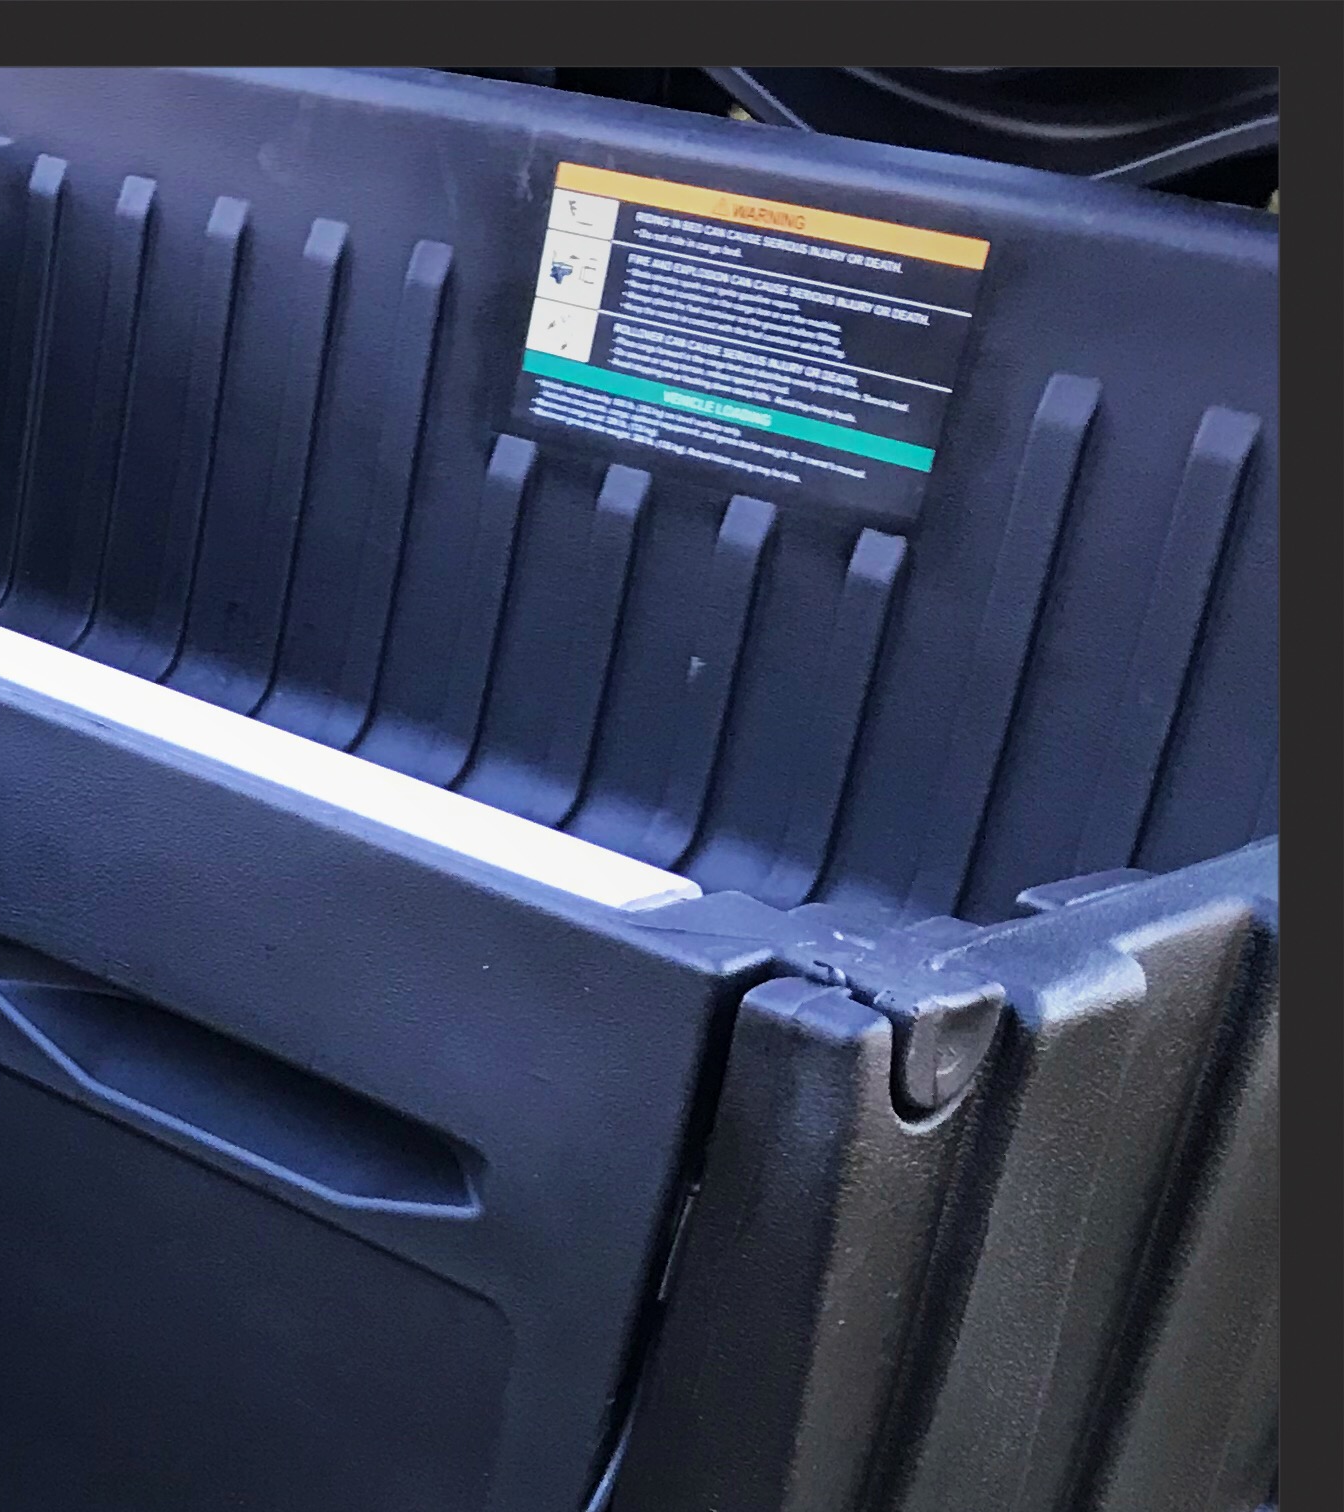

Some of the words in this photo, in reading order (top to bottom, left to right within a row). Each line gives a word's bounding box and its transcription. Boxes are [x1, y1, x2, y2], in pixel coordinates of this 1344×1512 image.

[732, 204, 806, 230] WARNING
[704, 225, 726, 238] CAN
[727, 229, 762, 246] CAUSE
[763, 236, 808, 255] SERIOUS
[808, 246, 846, 262] INJURY
[846, 253, 864, 266] OR
[729, 274, 752, 288] CAN
[752, 279, 789, 296] CAUSE
[789, 286, 835, 305] SERIOUS
[835, 296, 873, 313] INJURY
[873, 304, 891, 317] OR
[686, 339, 723, 356] CAUSE
[723, 347, 768, 367] SERIOUS
[663, 390, 715, 413] VEHICLE
